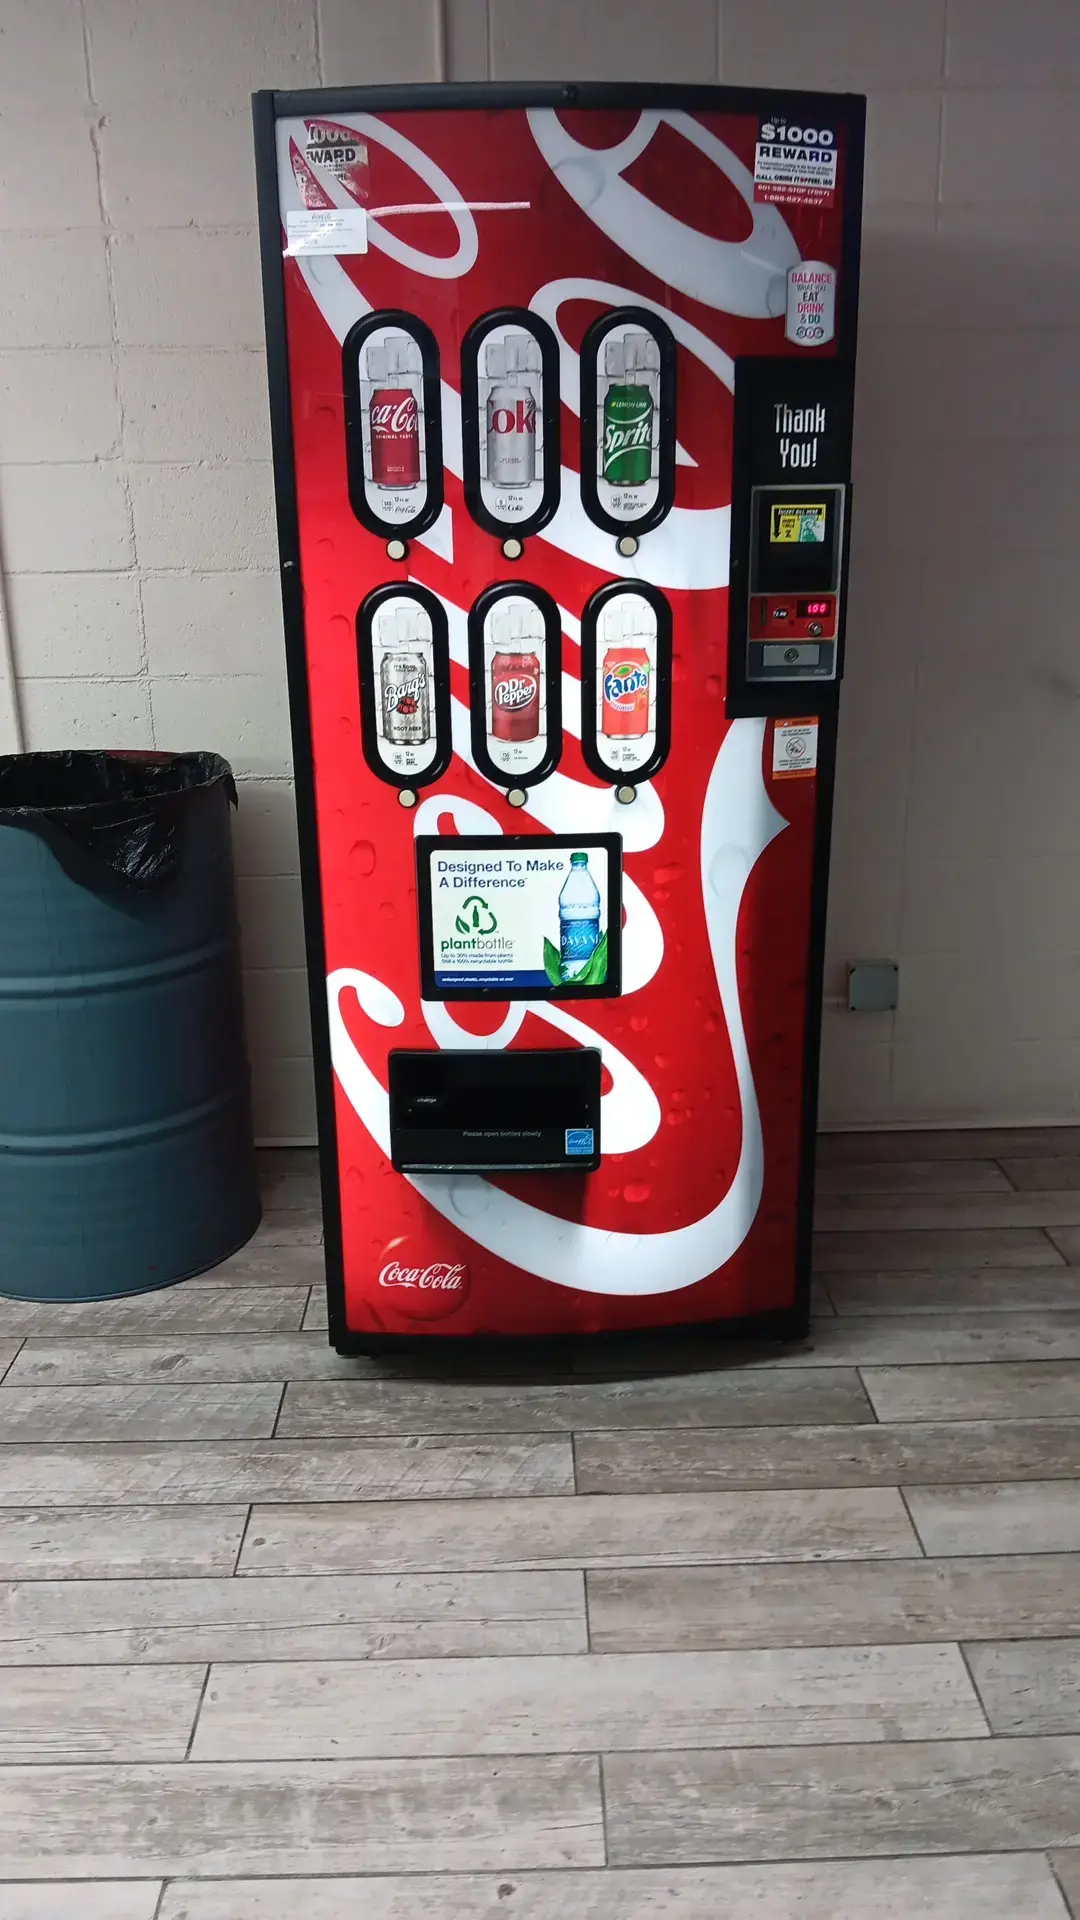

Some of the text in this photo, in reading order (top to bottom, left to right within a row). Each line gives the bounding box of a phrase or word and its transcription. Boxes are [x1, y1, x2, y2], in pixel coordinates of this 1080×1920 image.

[761, 122, 834, 146] $1000
[306, 148, 356, 163] WARD
[759, 146, 833, 163] REWARD
[791, 272, 832, 284] BALANCE
[802, 292, 819, 302] EAT
[797, 303, 824, 313] DRINK
[808, 315, 821, 324] DO
[487, 399, 537, 435] ok
[774, 403, 826, 433] Thank
[780, 437, 817, 468] You!
[508, 677, 526, 692] Dr
[384, 672, 426, 714] Barq's
[494, 680, 536, 706] Pepper
[437, 859, 565, 875] Designed To Make
[439, 876, 526, 888] A Difference
[441, 936, 514, 952] plantbottle
[379, 1261, 467, 1289] Coca-Cola
